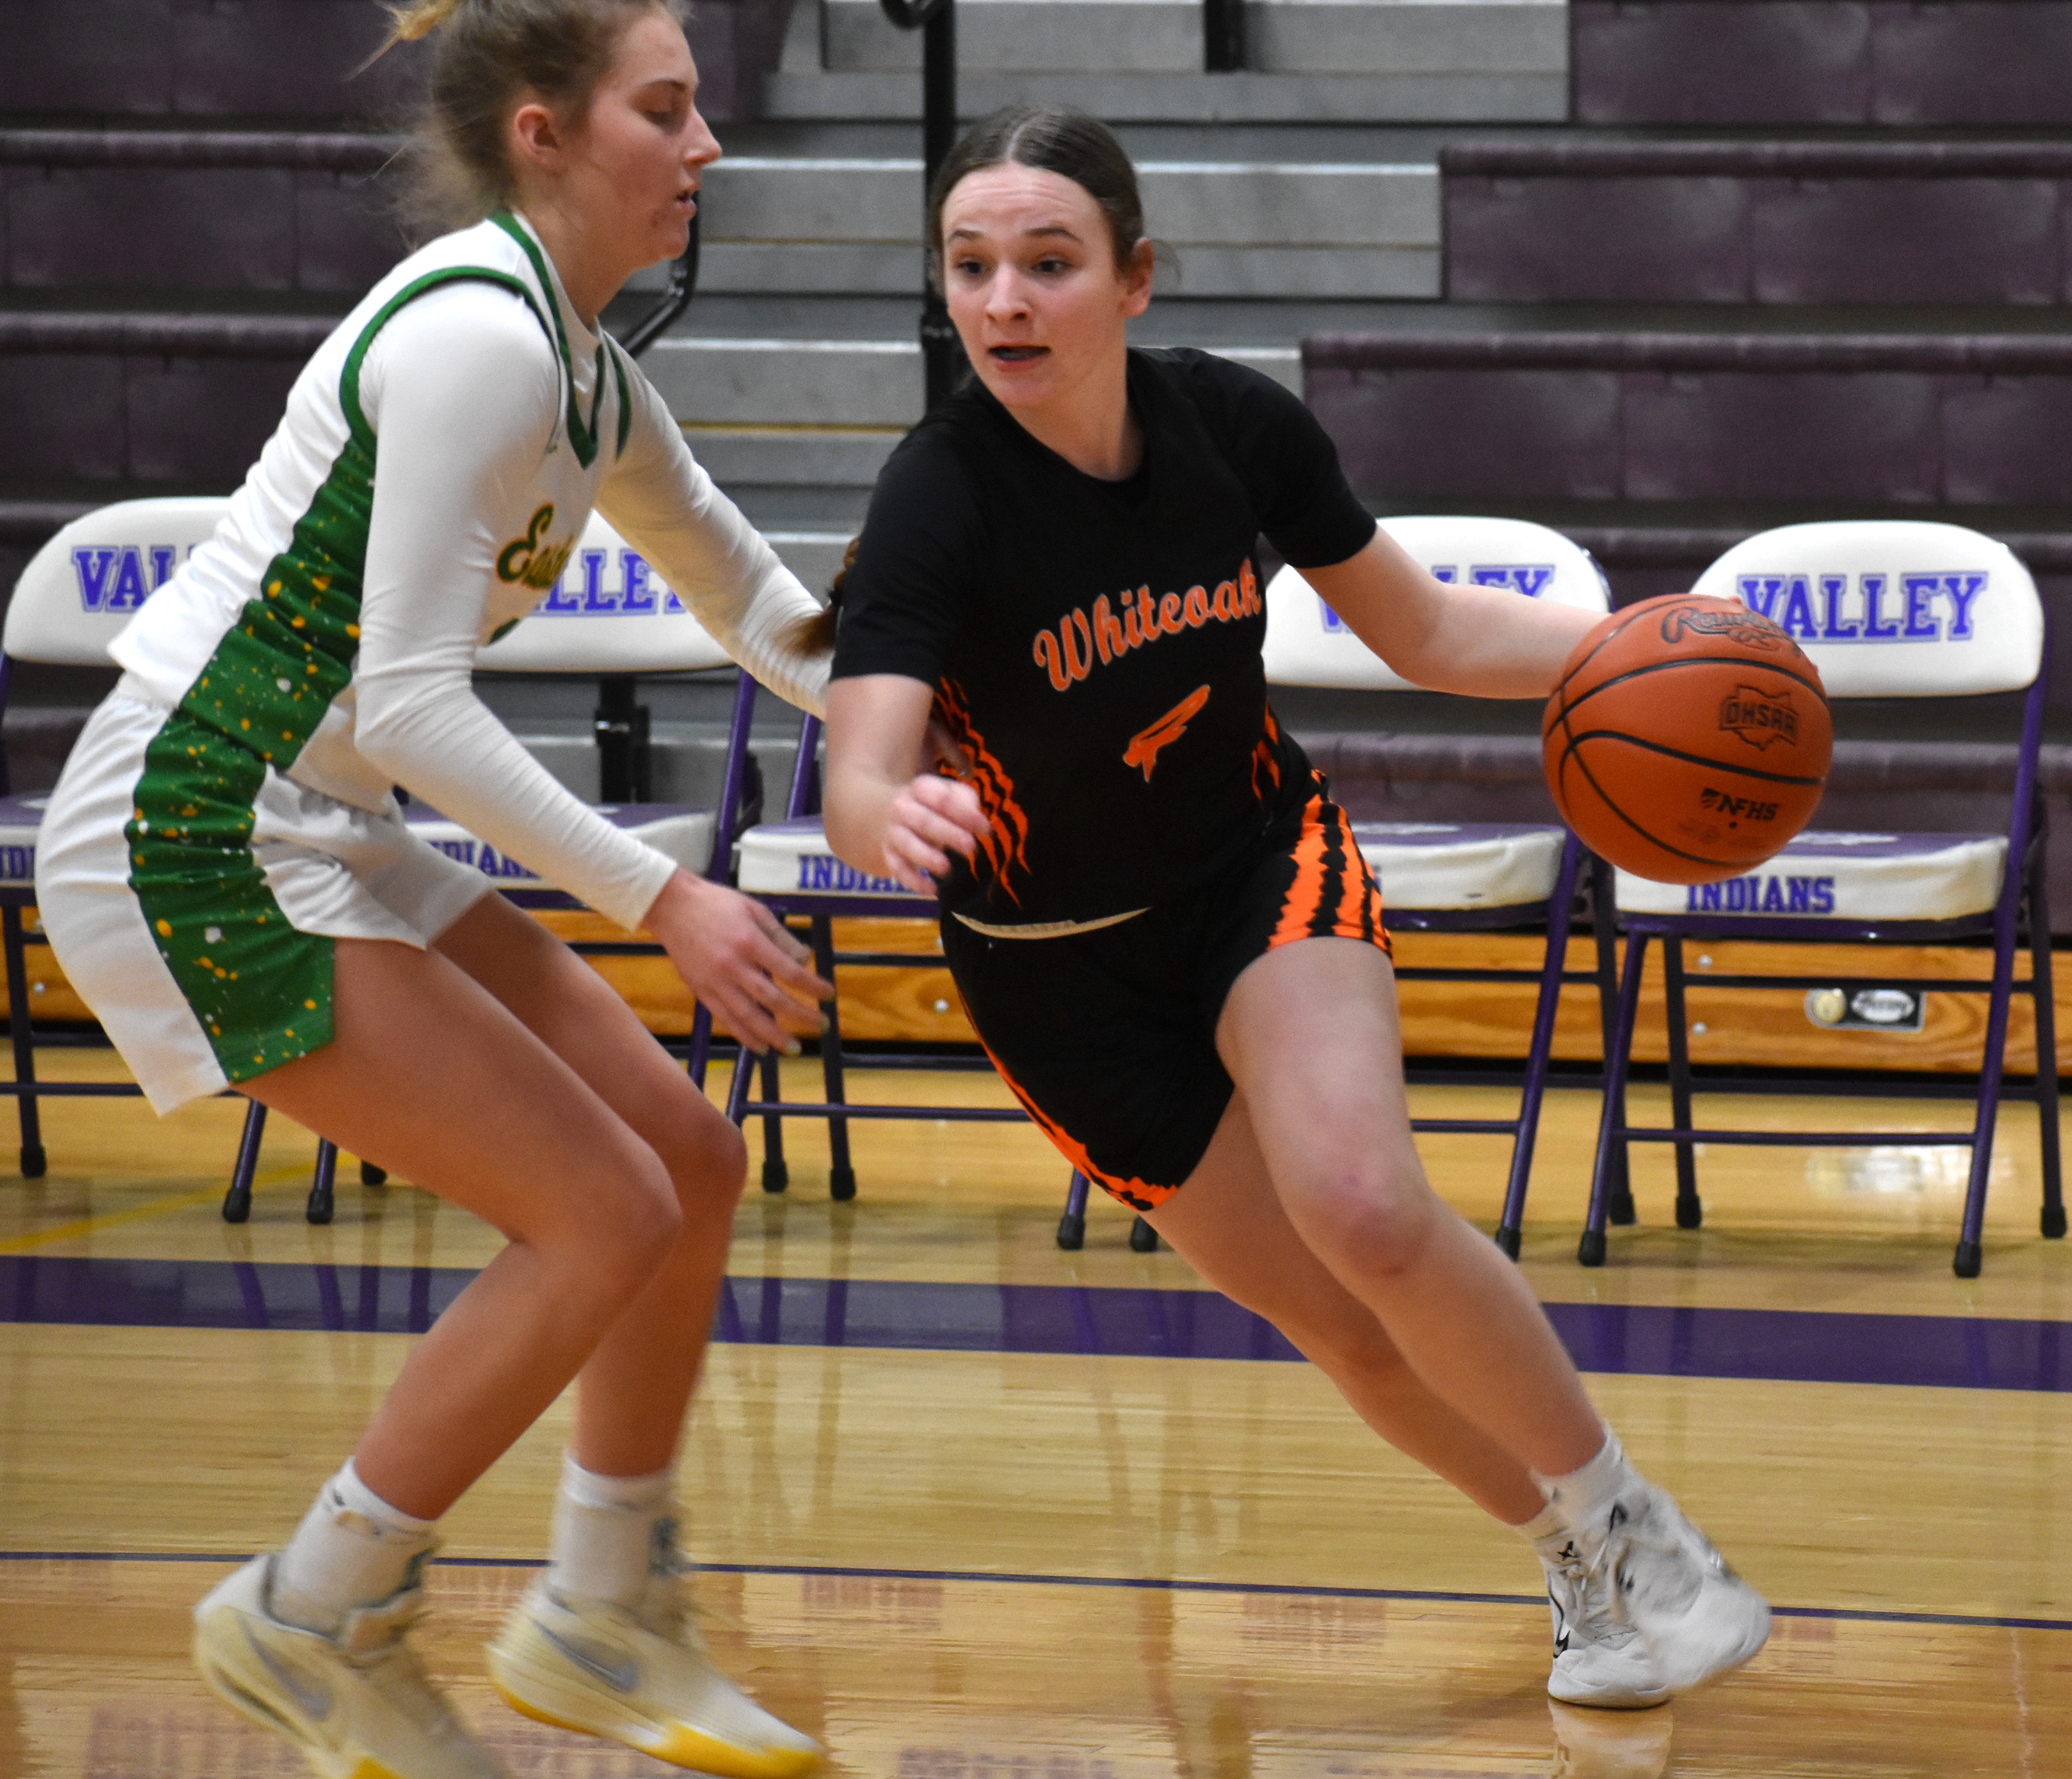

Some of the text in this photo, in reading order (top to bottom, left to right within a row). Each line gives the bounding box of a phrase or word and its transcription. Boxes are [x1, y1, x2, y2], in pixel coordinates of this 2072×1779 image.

[1033, 556, 1262, 692] Whiteoak
[1737, 571, 1989, 644] VALLEY
[1717, 794, 1778, 821] NFHS
[1686, 876, 1835, 914] INDIANS
